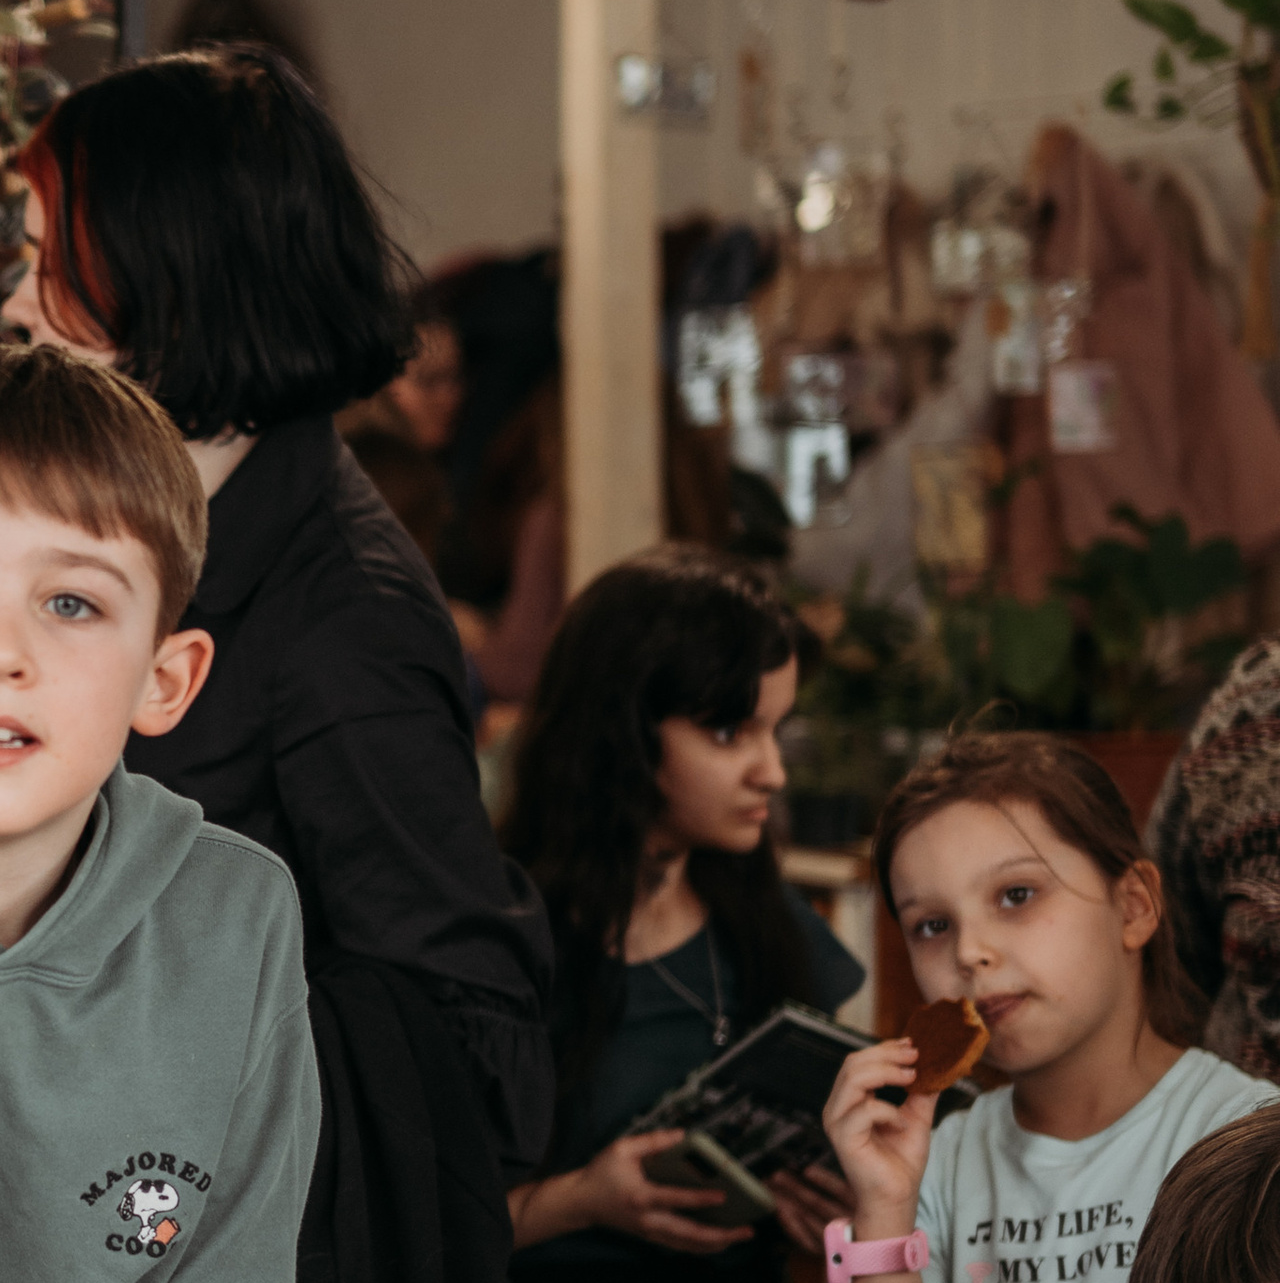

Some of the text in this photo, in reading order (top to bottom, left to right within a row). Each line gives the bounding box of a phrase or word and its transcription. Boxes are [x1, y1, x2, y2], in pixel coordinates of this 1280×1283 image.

[80, 1151, 212, 1206] MAJORED
[1001, 1201, 1132, 1243] MY LIFE,
[105, 1233, 177, 1258] COO
